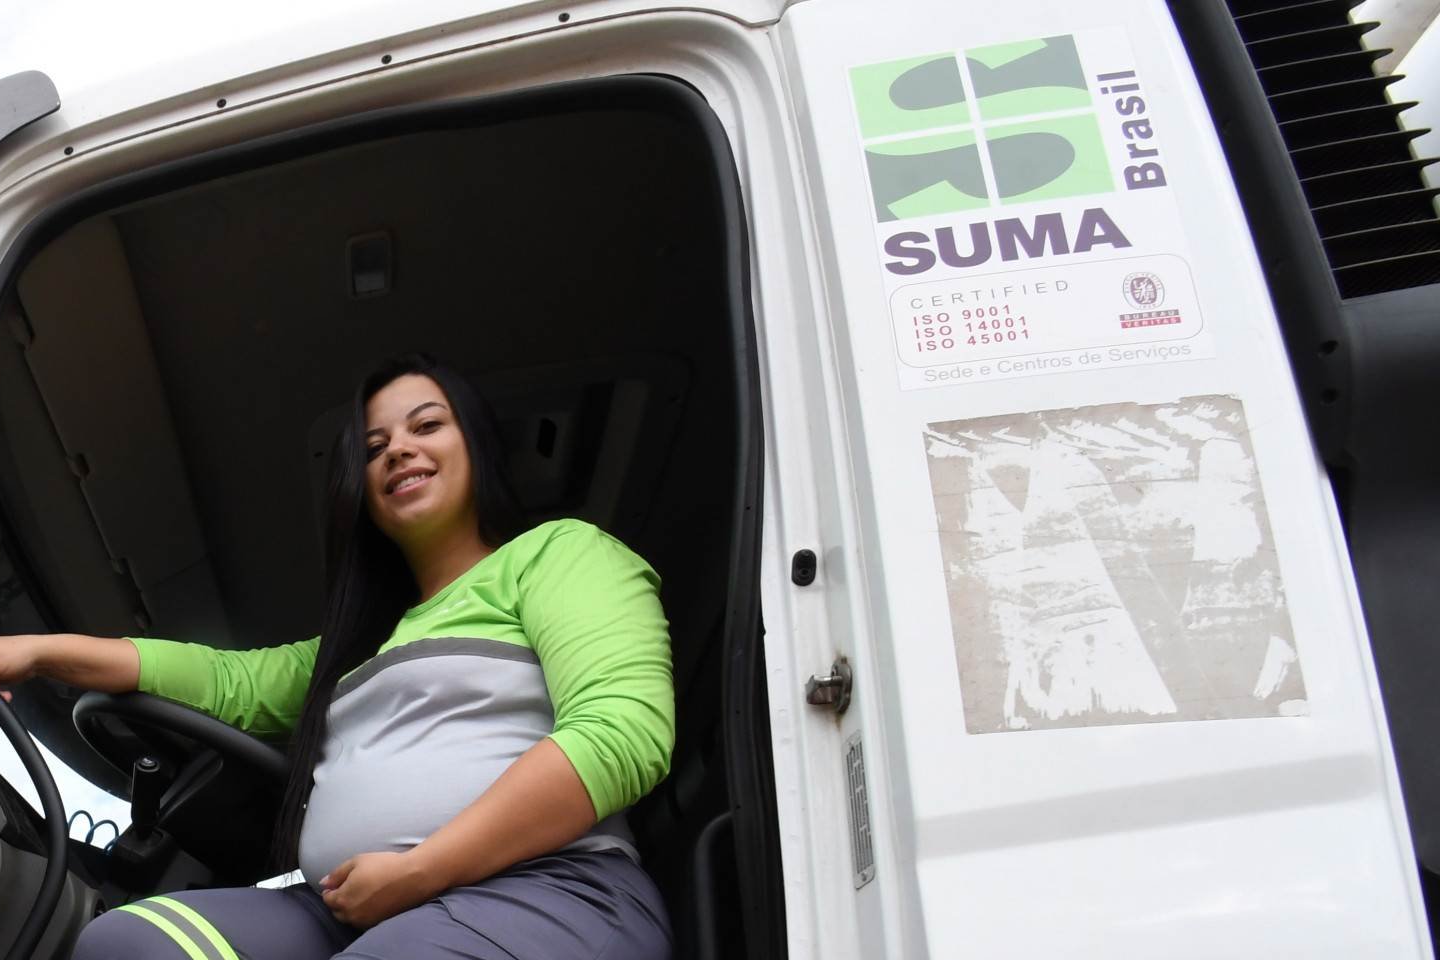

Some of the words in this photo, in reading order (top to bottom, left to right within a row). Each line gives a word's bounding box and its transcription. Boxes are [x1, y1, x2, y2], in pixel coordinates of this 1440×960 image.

[1097, 70, 1167, 190] Brasil
[884, 208, 1132, 275] SUMA
[910, 279, 1070, 309] CERTIFIED
[913, 312, 950, 326] ISO
[962, 304, 1011, 320] 9001
[915, 325, 952, 339] ISO
[966, 316, 1027, 333] 14001
[917, 338, 955, 352] ISO
[967, 329, 1030, 346] 45001
[924, 366, 973, 382] Sede
[979, 365, 991, 376] e
[997, 354, 1073, 374] Centros
[1078, 348, 1102, 366] de
[1108, 343, 1191, 362] Serviços
